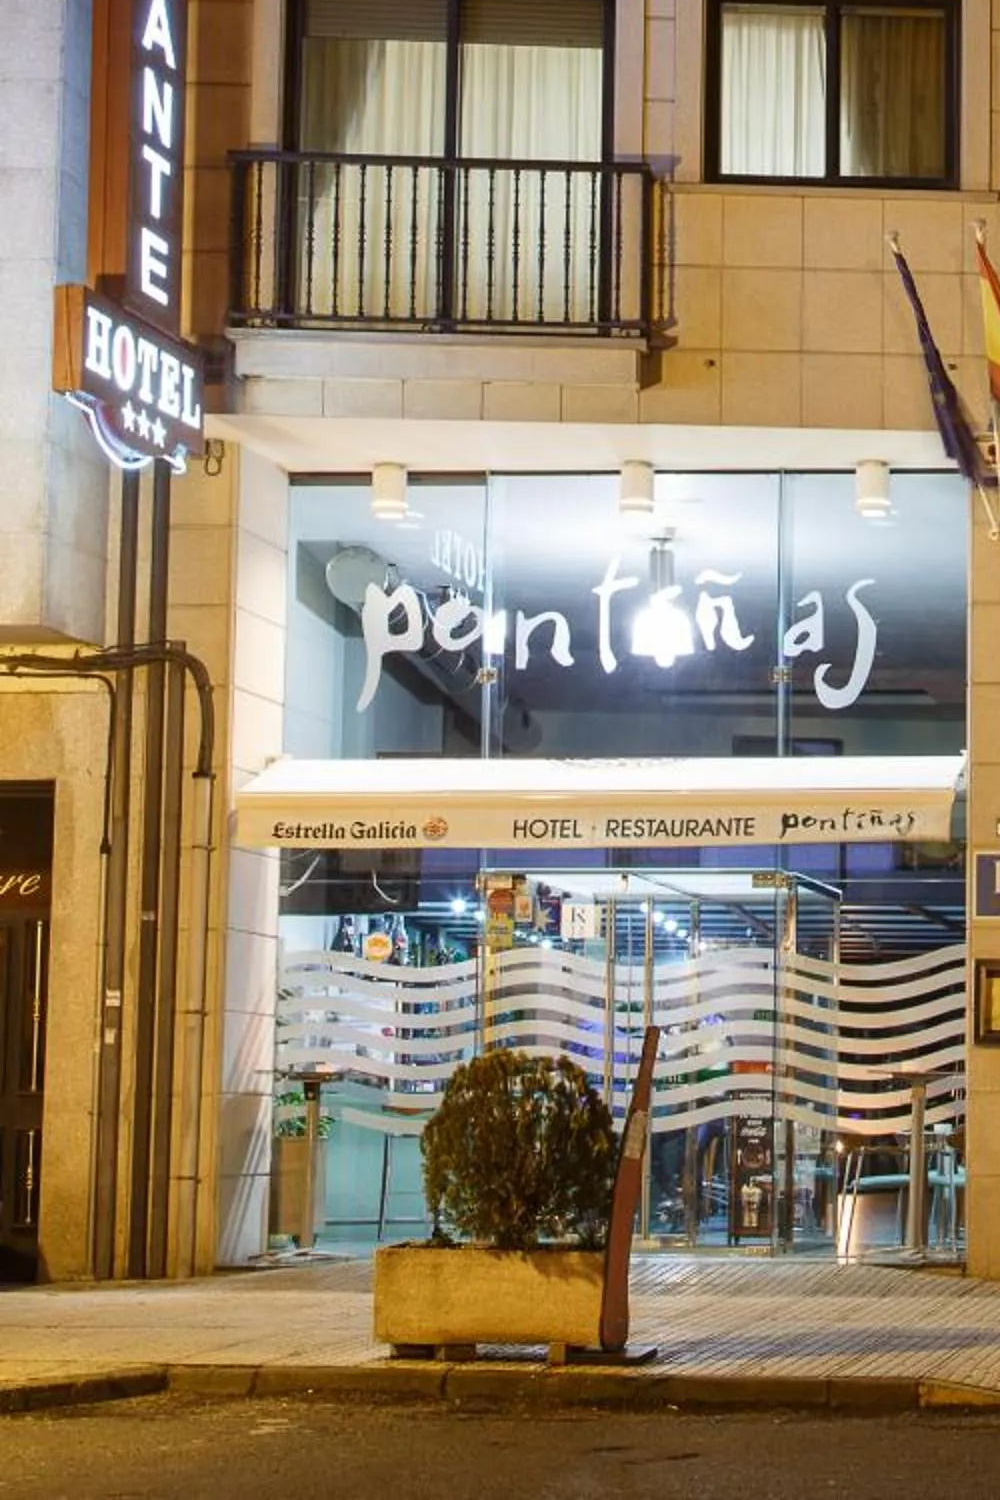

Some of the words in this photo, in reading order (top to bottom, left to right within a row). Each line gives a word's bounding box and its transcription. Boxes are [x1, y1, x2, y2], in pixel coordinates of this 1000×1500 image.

[85, 305, 201, 429] HOTEL
[357, 556, 878, 712] pontñas
[271, 821, 345, 840] Estrella
[350, 820, 417, 840] Galicia
[512, 818, 582, 840] HOTEL
[605, 816, 756, 838] RESTAURANTE
